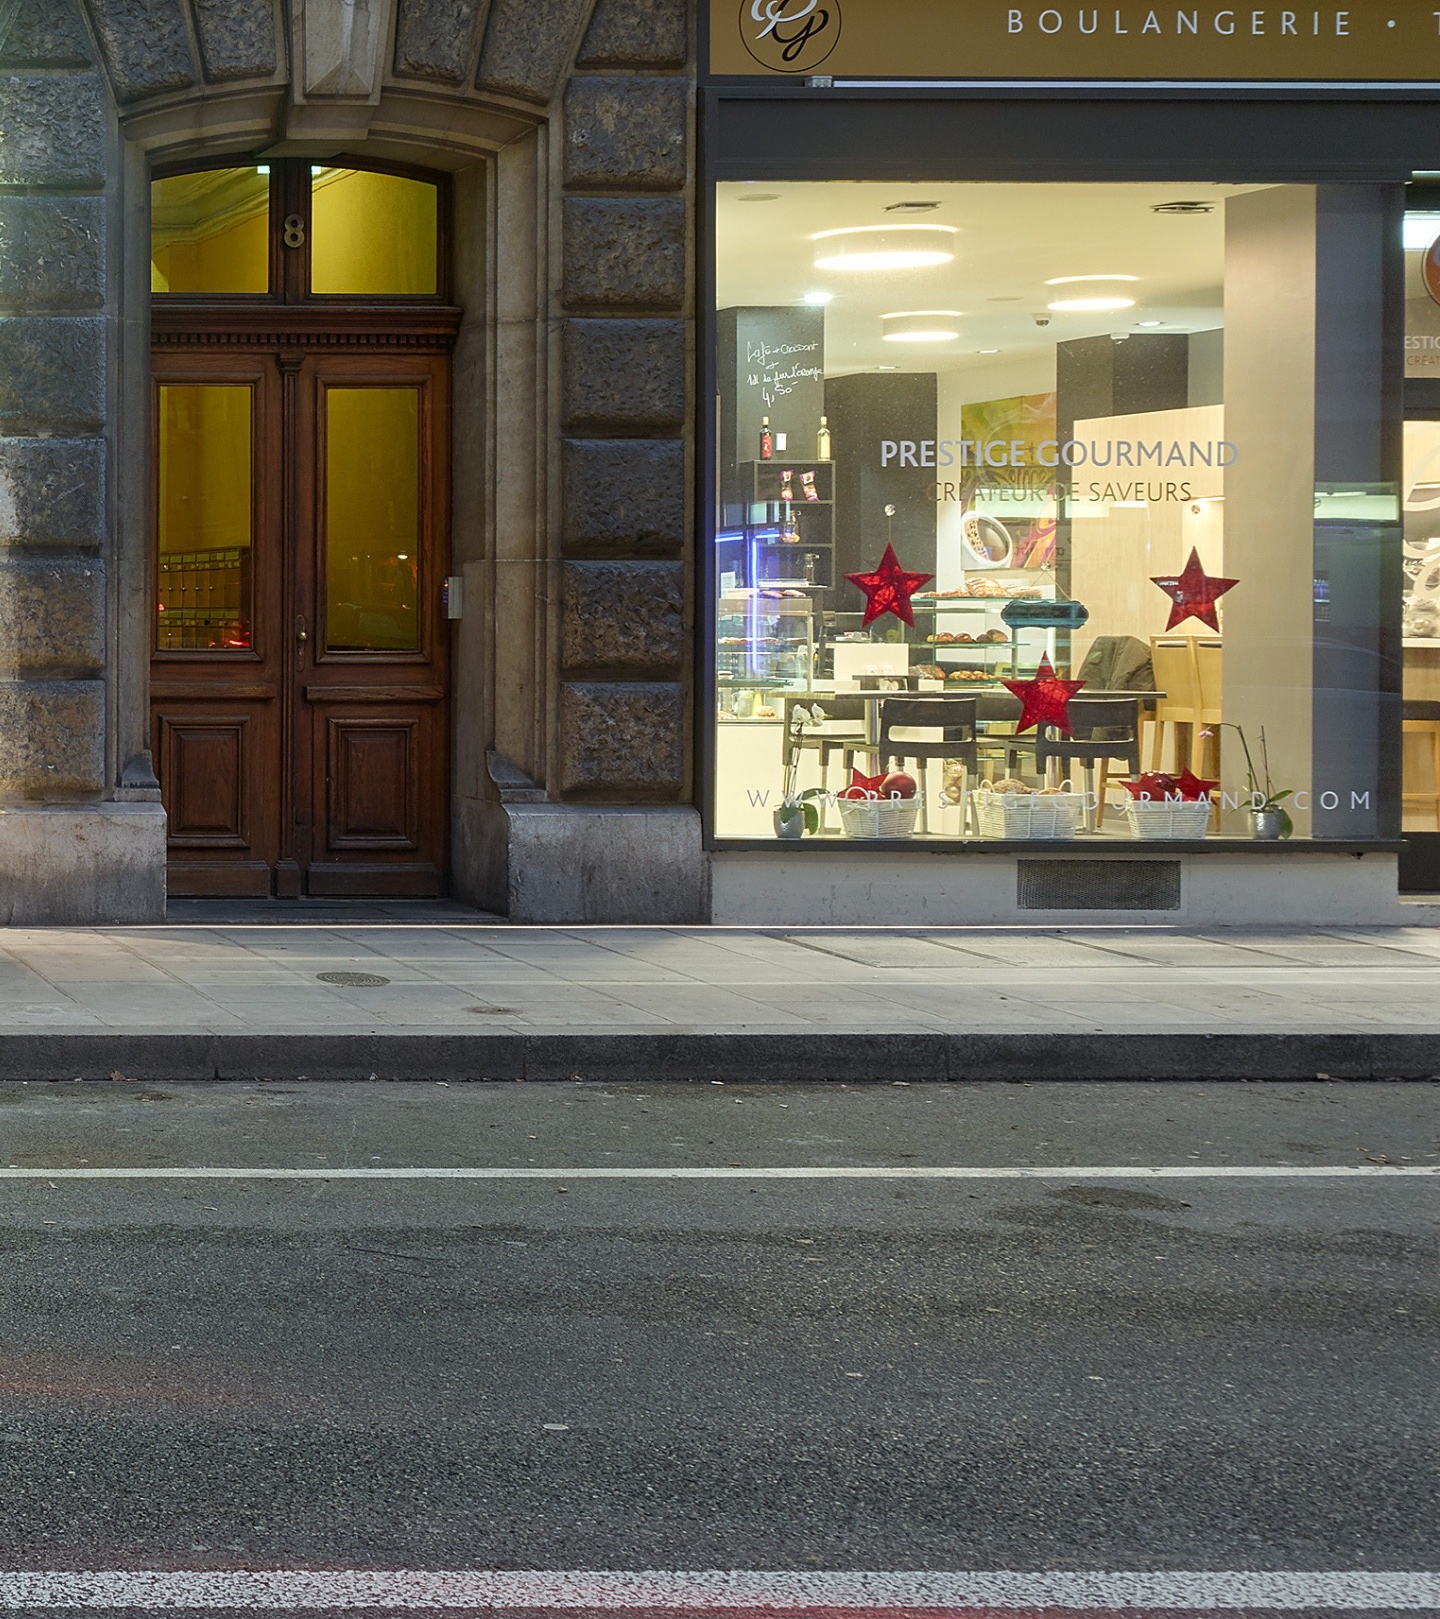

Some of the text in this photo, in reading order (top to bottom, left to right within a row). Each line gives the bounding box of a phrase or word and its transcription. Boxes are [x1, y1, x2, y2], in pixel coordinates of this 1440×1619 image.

[1007, 9, 1350, 36] BOULANGERIE
[283, 213, 305, 249] 8
[880, 440, 1239, 468] PRESTIGE GOURMAND
[1051, 482, 1080, 501] DE
[1089, 482, 1192, 502] SAVEURS
